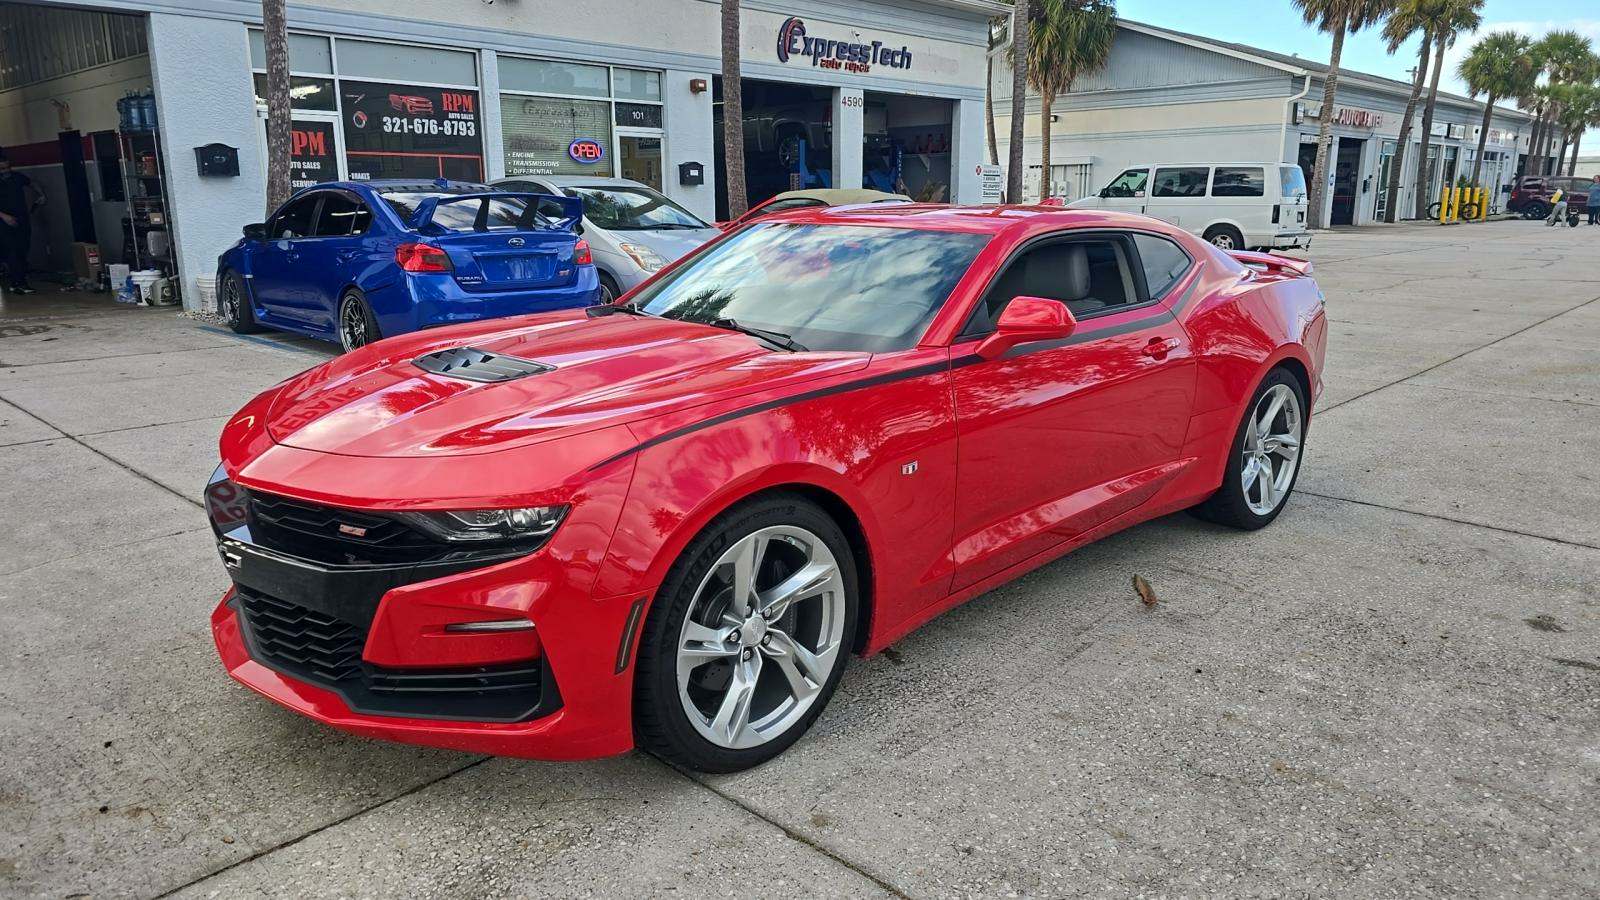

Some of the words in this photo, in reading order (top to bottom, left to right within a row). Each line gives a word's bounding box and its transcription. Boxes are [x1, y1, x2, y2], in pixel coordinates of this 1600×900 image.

[787, 29, 913, 69] ExpressTech
[819, 58, 842, 70] auto
[441, 92, 474, 112] RPM
[841, 96, 864, 107] 4590
[631, 111, 644, 120] 101
[1340, 109, 1359, 126] AUTO
[382, 116, 476, 137] 321-676-8793
[290, 130, 326, 156] PM
[572, 143, 601, 158] OPEN
[290, 161, 302, 169] UTO
[302, 161, 321, 170] SALES
